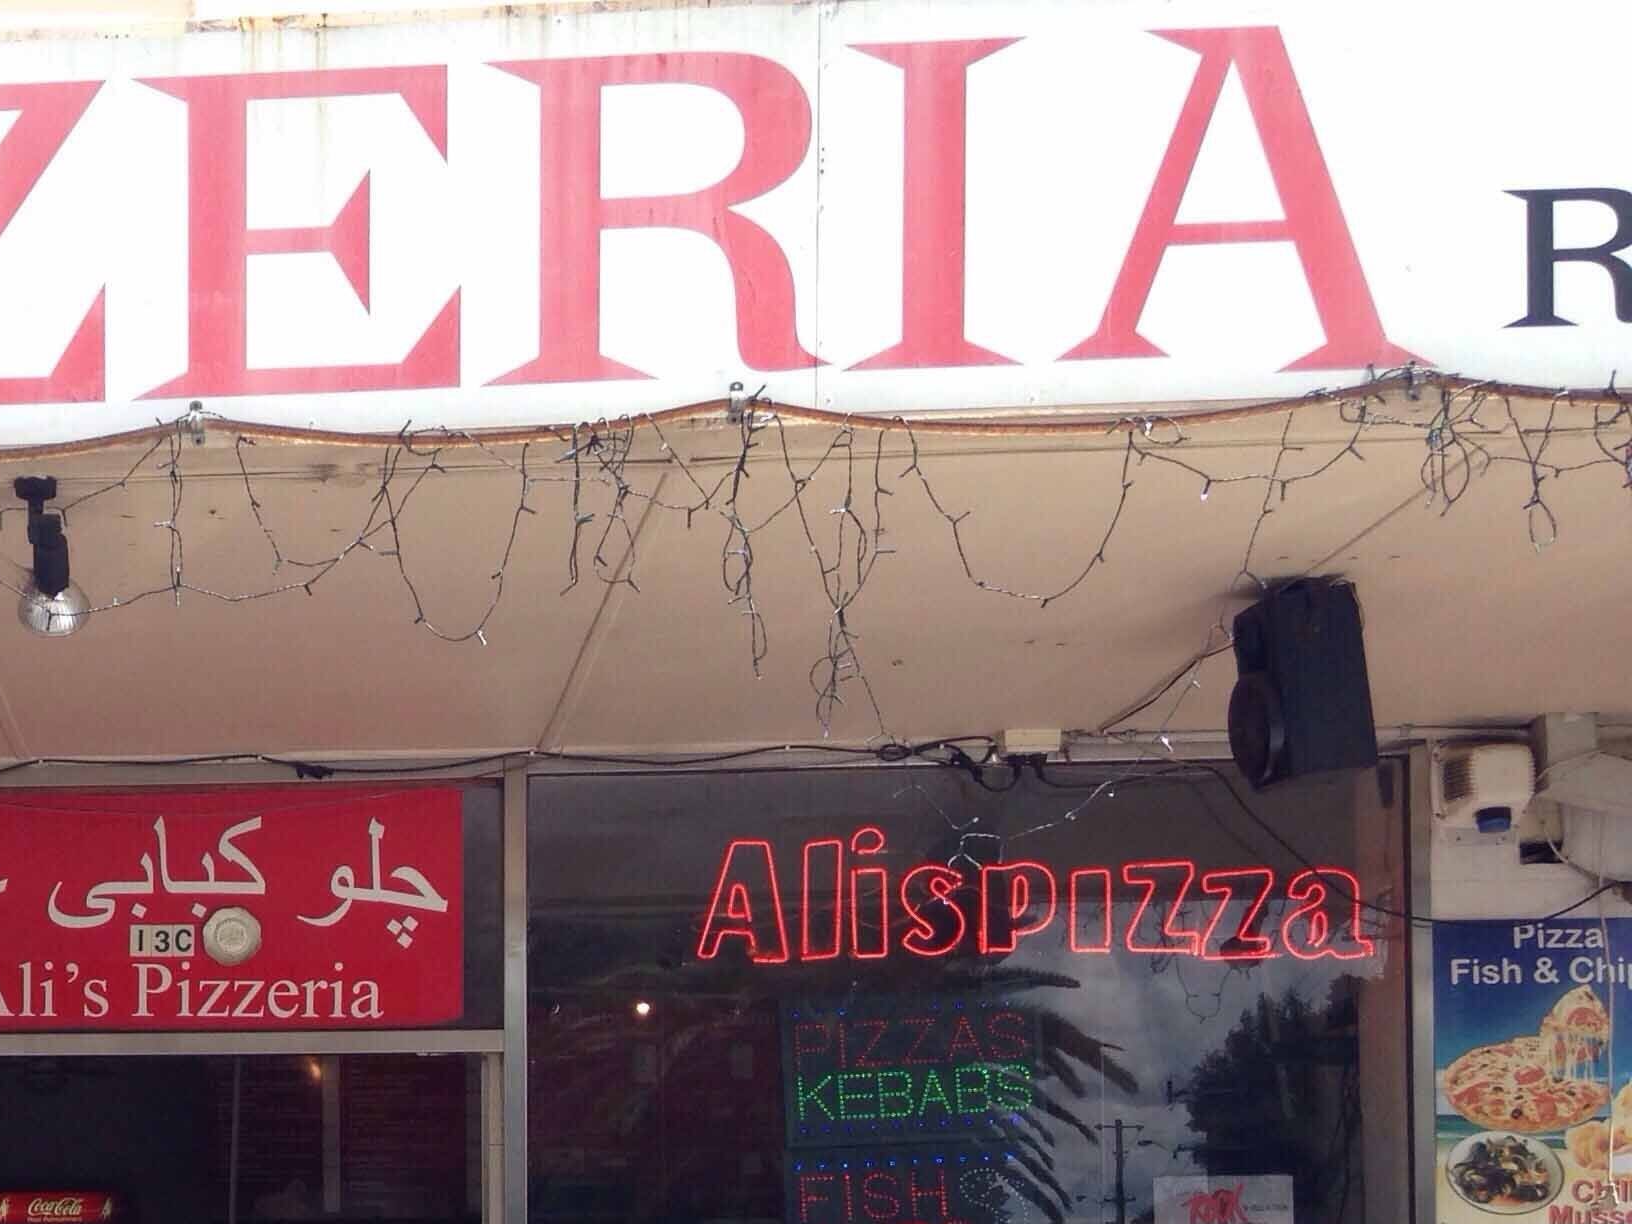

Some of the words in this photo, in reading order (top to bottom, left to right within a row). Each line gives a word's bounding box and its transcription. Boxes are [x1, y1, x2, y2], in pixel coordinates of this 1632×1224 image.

[296, 816, 448, 949] چلو
[1513, 923, 1604, 949] Pizza
[131, 961, 384, 1019] Pizzeria
[1450, 957, 1523, 985] Fish
[1533, 956, 1560, 984] &
[794, 1011, 1030, 1070] PIZZAS
[796, 1063, 1033, 1121] KEBABS
[799, 1168, 949, 1224] FISH
